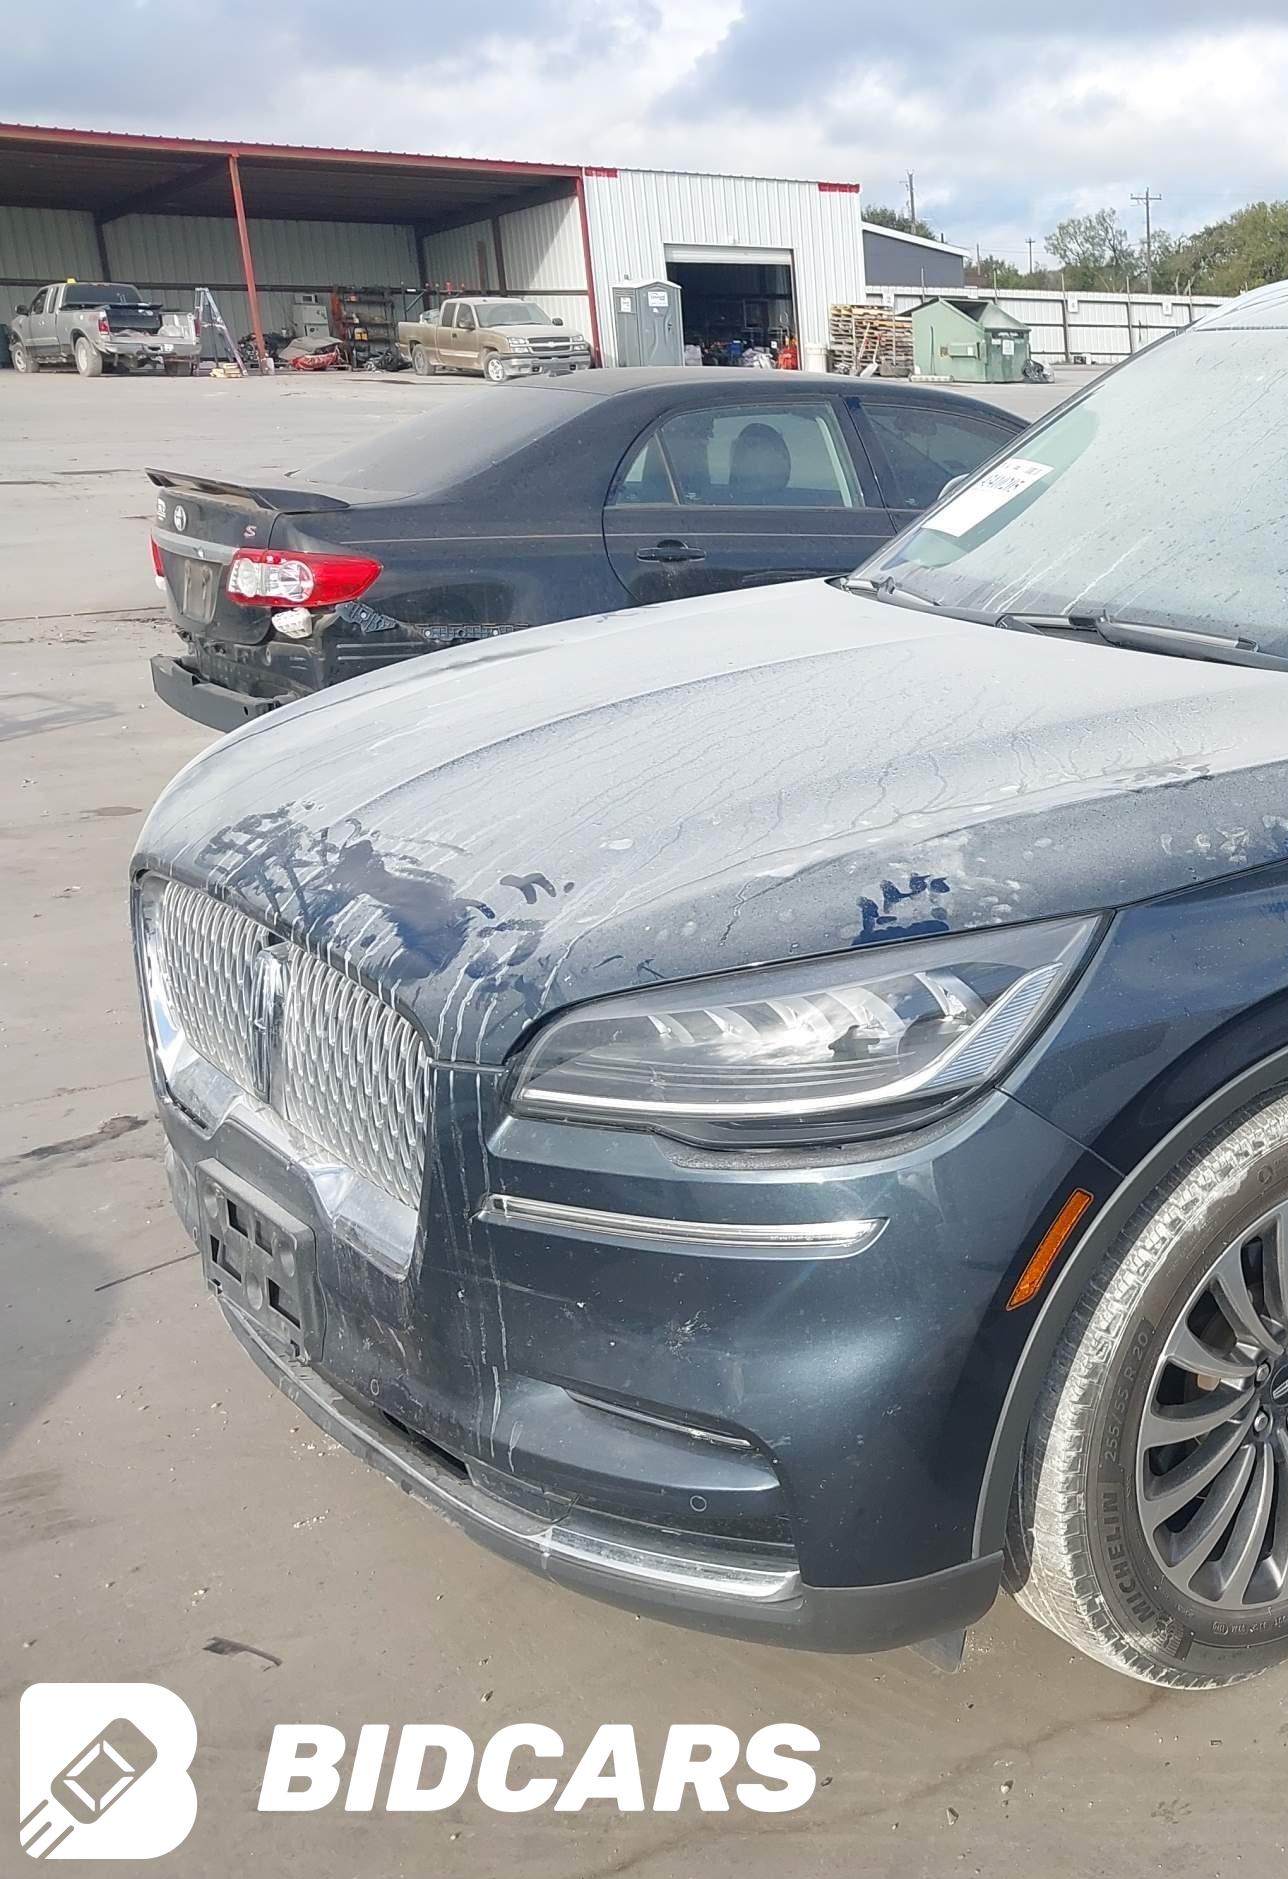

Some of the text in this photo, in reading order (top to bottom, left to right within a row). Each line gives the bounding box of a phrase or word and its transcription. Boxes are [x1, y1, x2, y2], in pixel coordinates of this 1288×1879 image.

[1104, 1333, 1149, 1463] 255/55 R 20
[1101, 1492, 1156, 1624] MICHELIN
